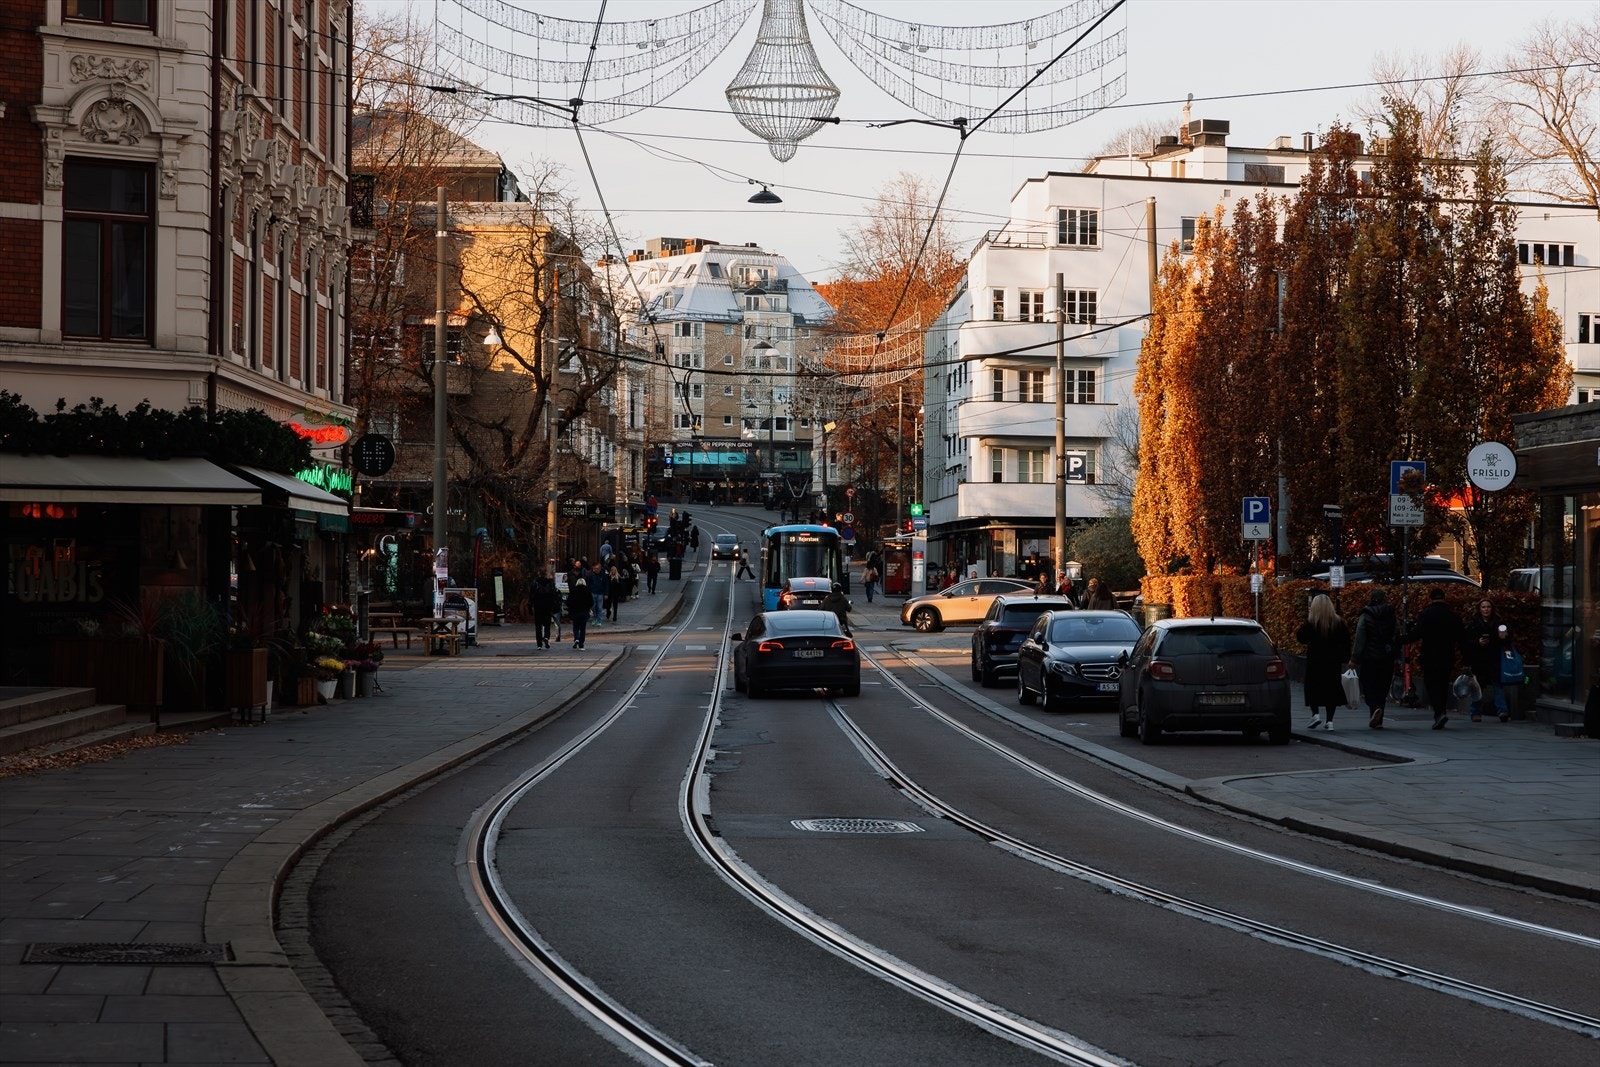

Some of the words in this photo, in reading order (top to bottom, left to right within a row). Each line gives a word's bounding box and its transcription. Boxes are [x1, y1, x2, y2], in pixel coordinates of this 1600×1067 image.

[1069, 456, 1083, 472] P
[1472, 468, 1511, 478] FRISLID
[1249, 500, 1264, 520] P
[844, 514, 853, 522] 30
